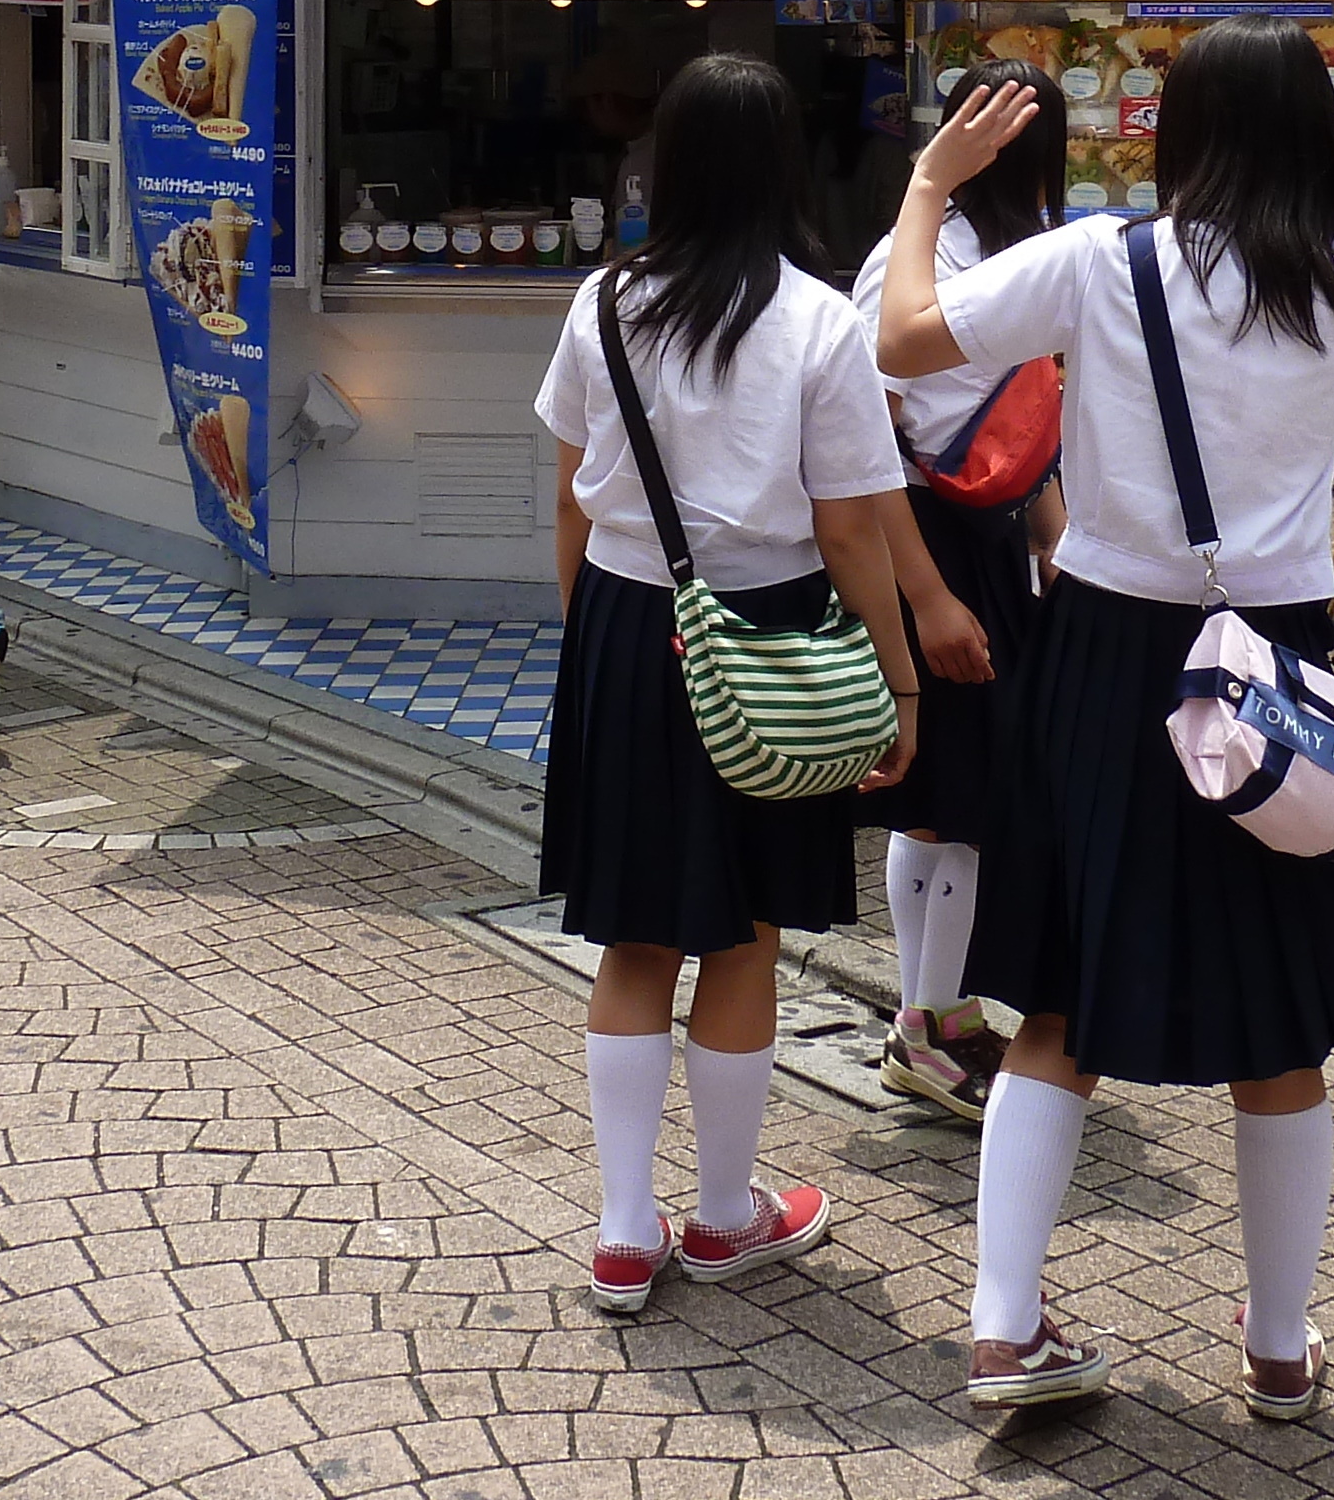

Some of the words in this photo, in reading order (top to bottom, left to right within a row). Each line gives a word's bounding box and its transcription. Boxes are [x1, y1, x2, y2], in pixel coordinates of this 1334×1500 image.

[232, 146, 266, 162] ¥490
[231, 342, 264, 361] ¥400
[1253, 695, 1325, 750] TOMMY
